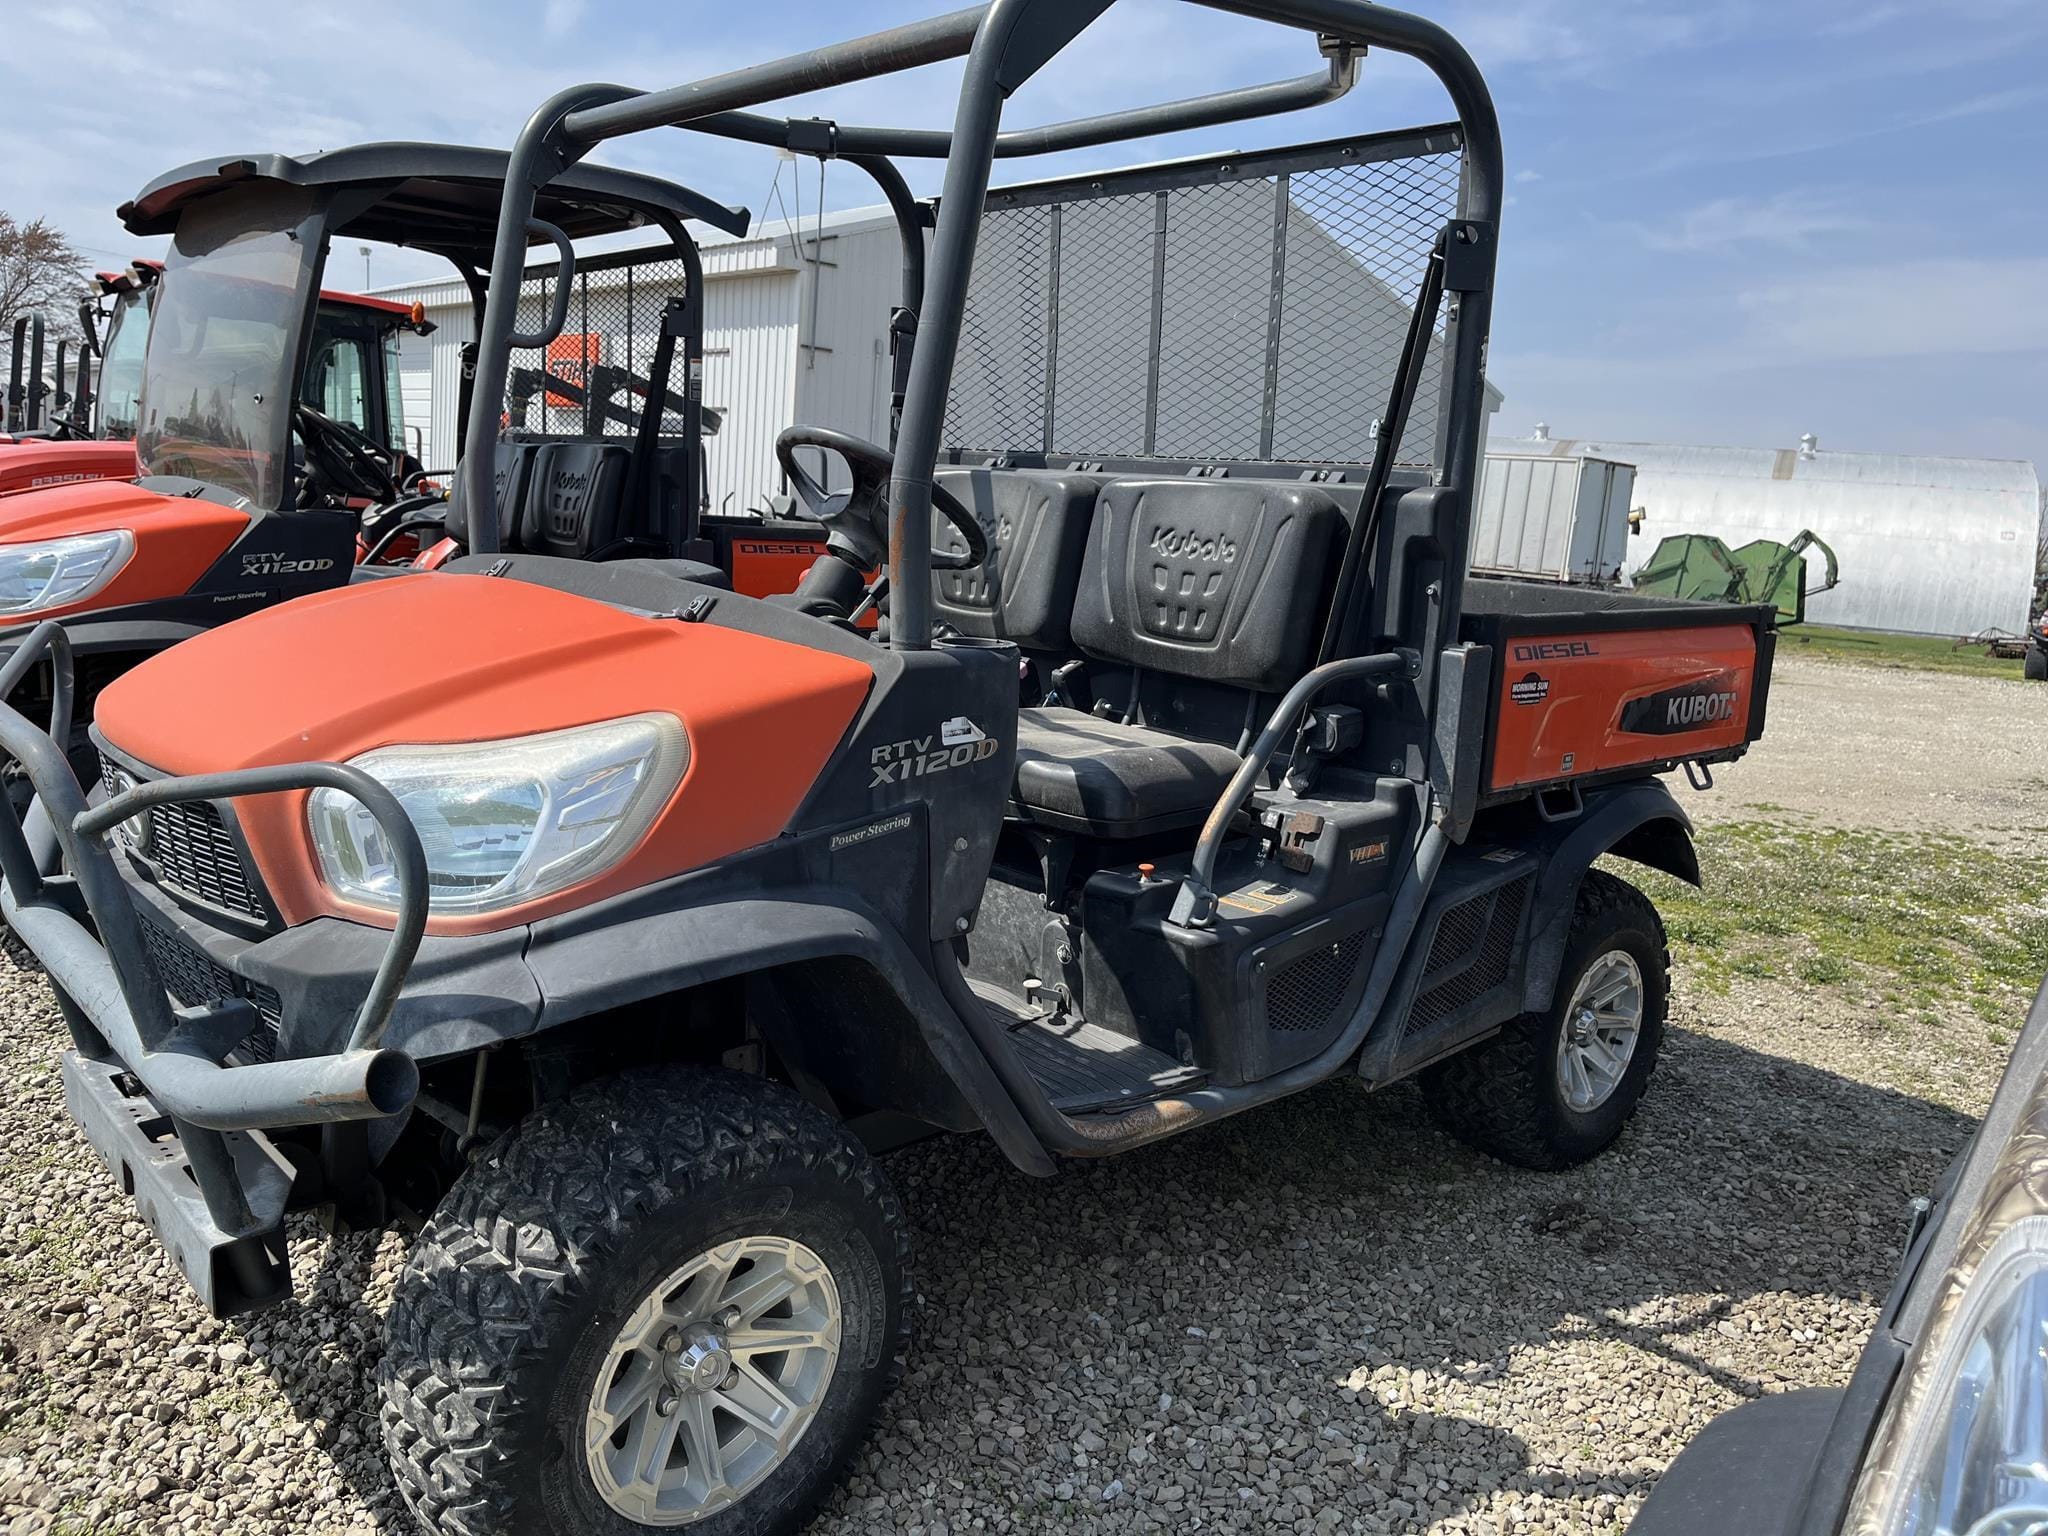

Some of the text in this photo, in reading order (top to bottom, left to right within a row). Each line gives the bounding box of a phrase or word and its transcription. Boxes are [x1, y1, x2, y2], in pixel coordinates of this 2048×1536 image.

[740, 544, 827, 555] DIESEL
[1150, 526, 1237, 563] Kubota
[240, 558, 334, 576] X1120D
[242, 552, 286, 563] RTV
[213, 591, 268, 603] Power Steering
[1514, 641, 1600, 661] DIESEL
[1512, 681, 1549, 693] MORNING SUN
[871, 735, 934, 764] RTV
[868, 737, 999, 789] X1120D
[831, 815, 911, 848] Power Steering
